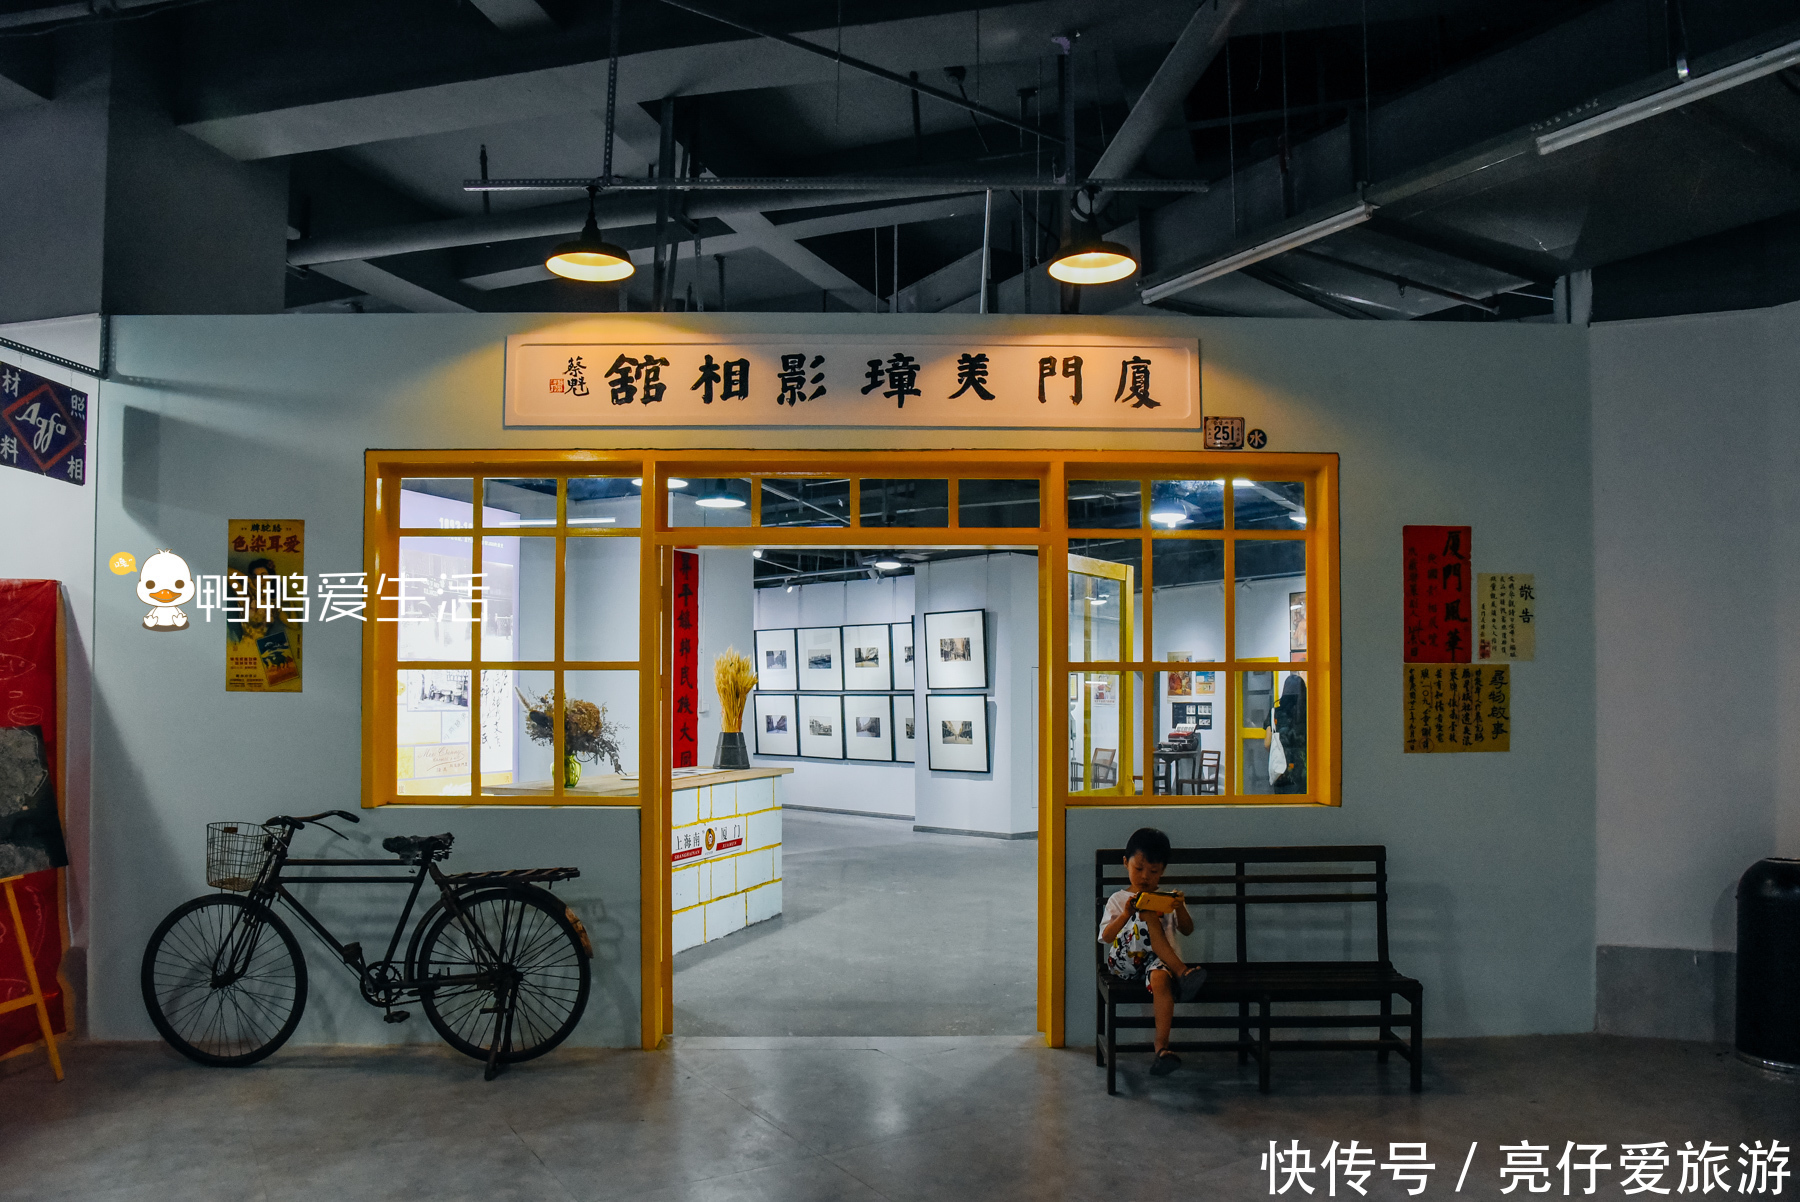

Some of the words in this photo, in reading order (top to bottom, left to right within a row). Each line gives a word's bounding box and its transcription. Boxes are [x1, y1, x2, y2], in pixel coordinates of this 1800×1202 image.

[15, 402, 67, 454] Agfa
[1214, 425, 1235, 441] 251
[1249, 430, 1265, 448] 水
[1518, 583, 1535, 624] 敬告
